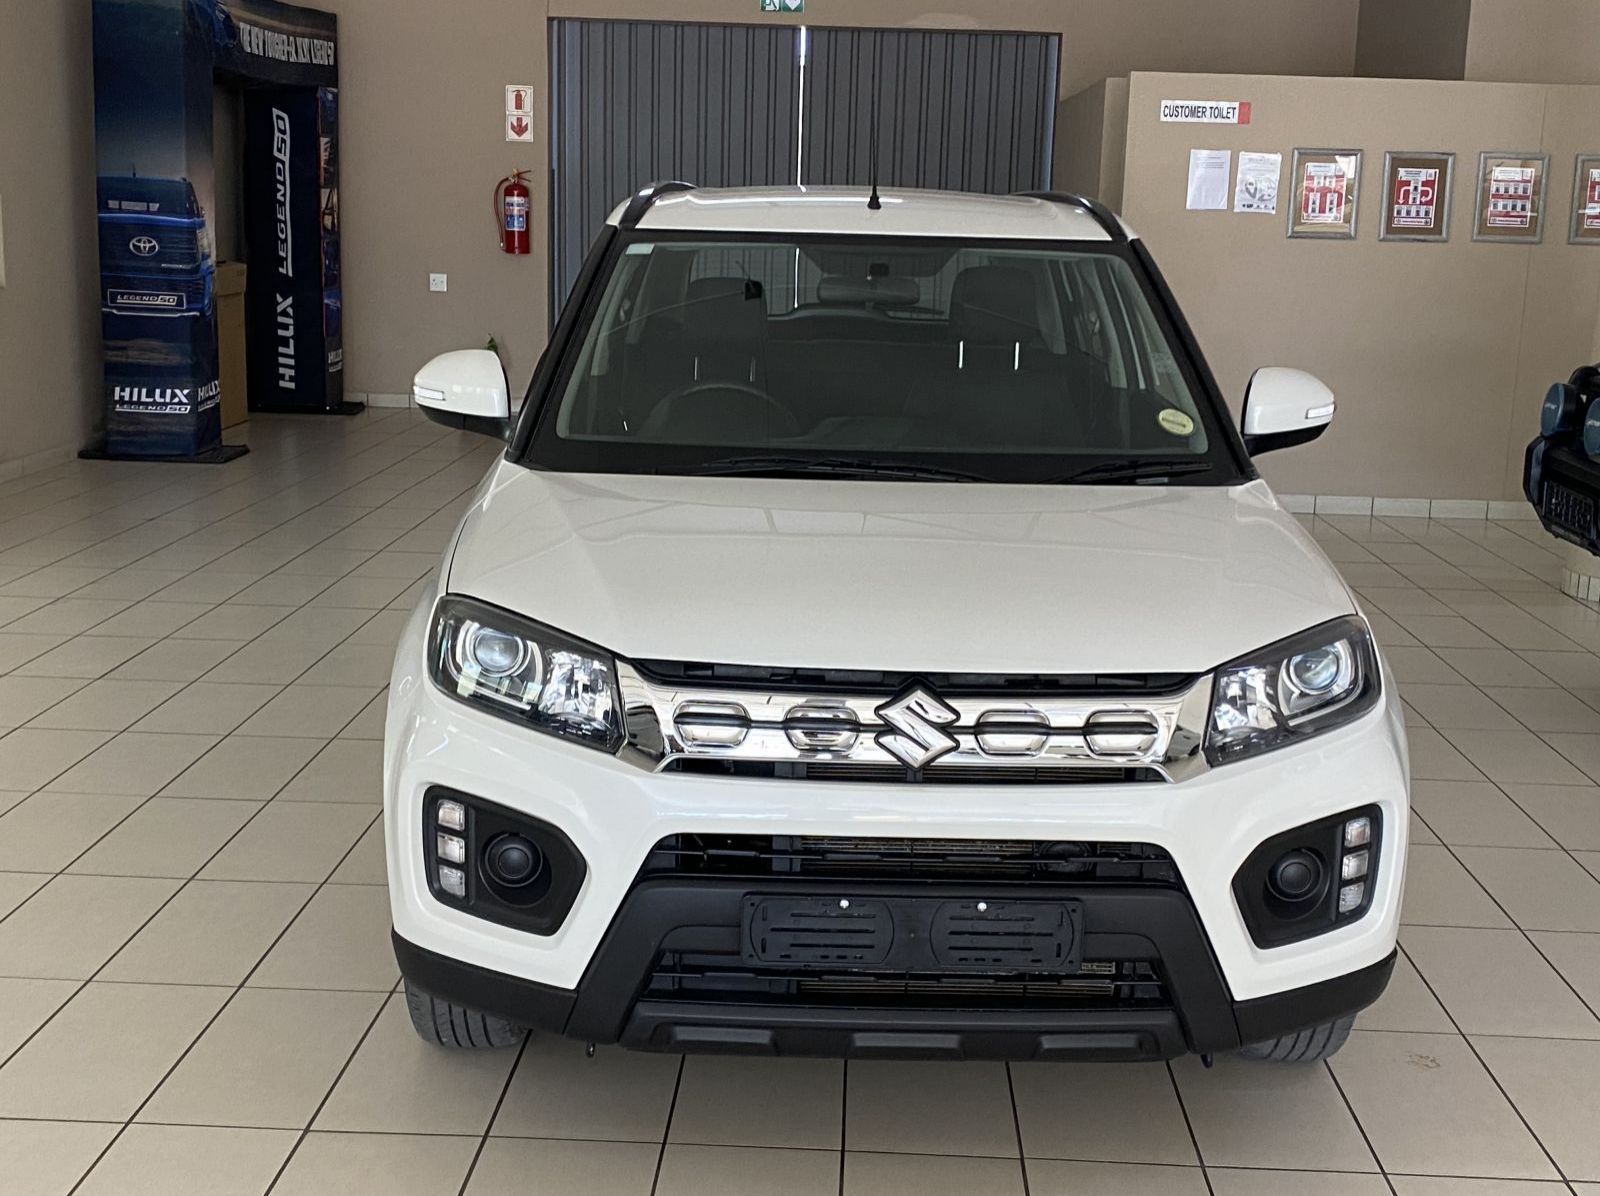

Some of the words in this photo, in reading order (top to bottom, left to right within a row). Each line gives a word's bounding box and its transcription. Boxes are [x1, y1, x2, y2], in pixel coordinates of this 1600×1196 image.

[1162, 104, 1208, 119] CUSTOMER
[1209, 106, 1237, 120] TOILET
[114, 386, 191, 404] HILUX
